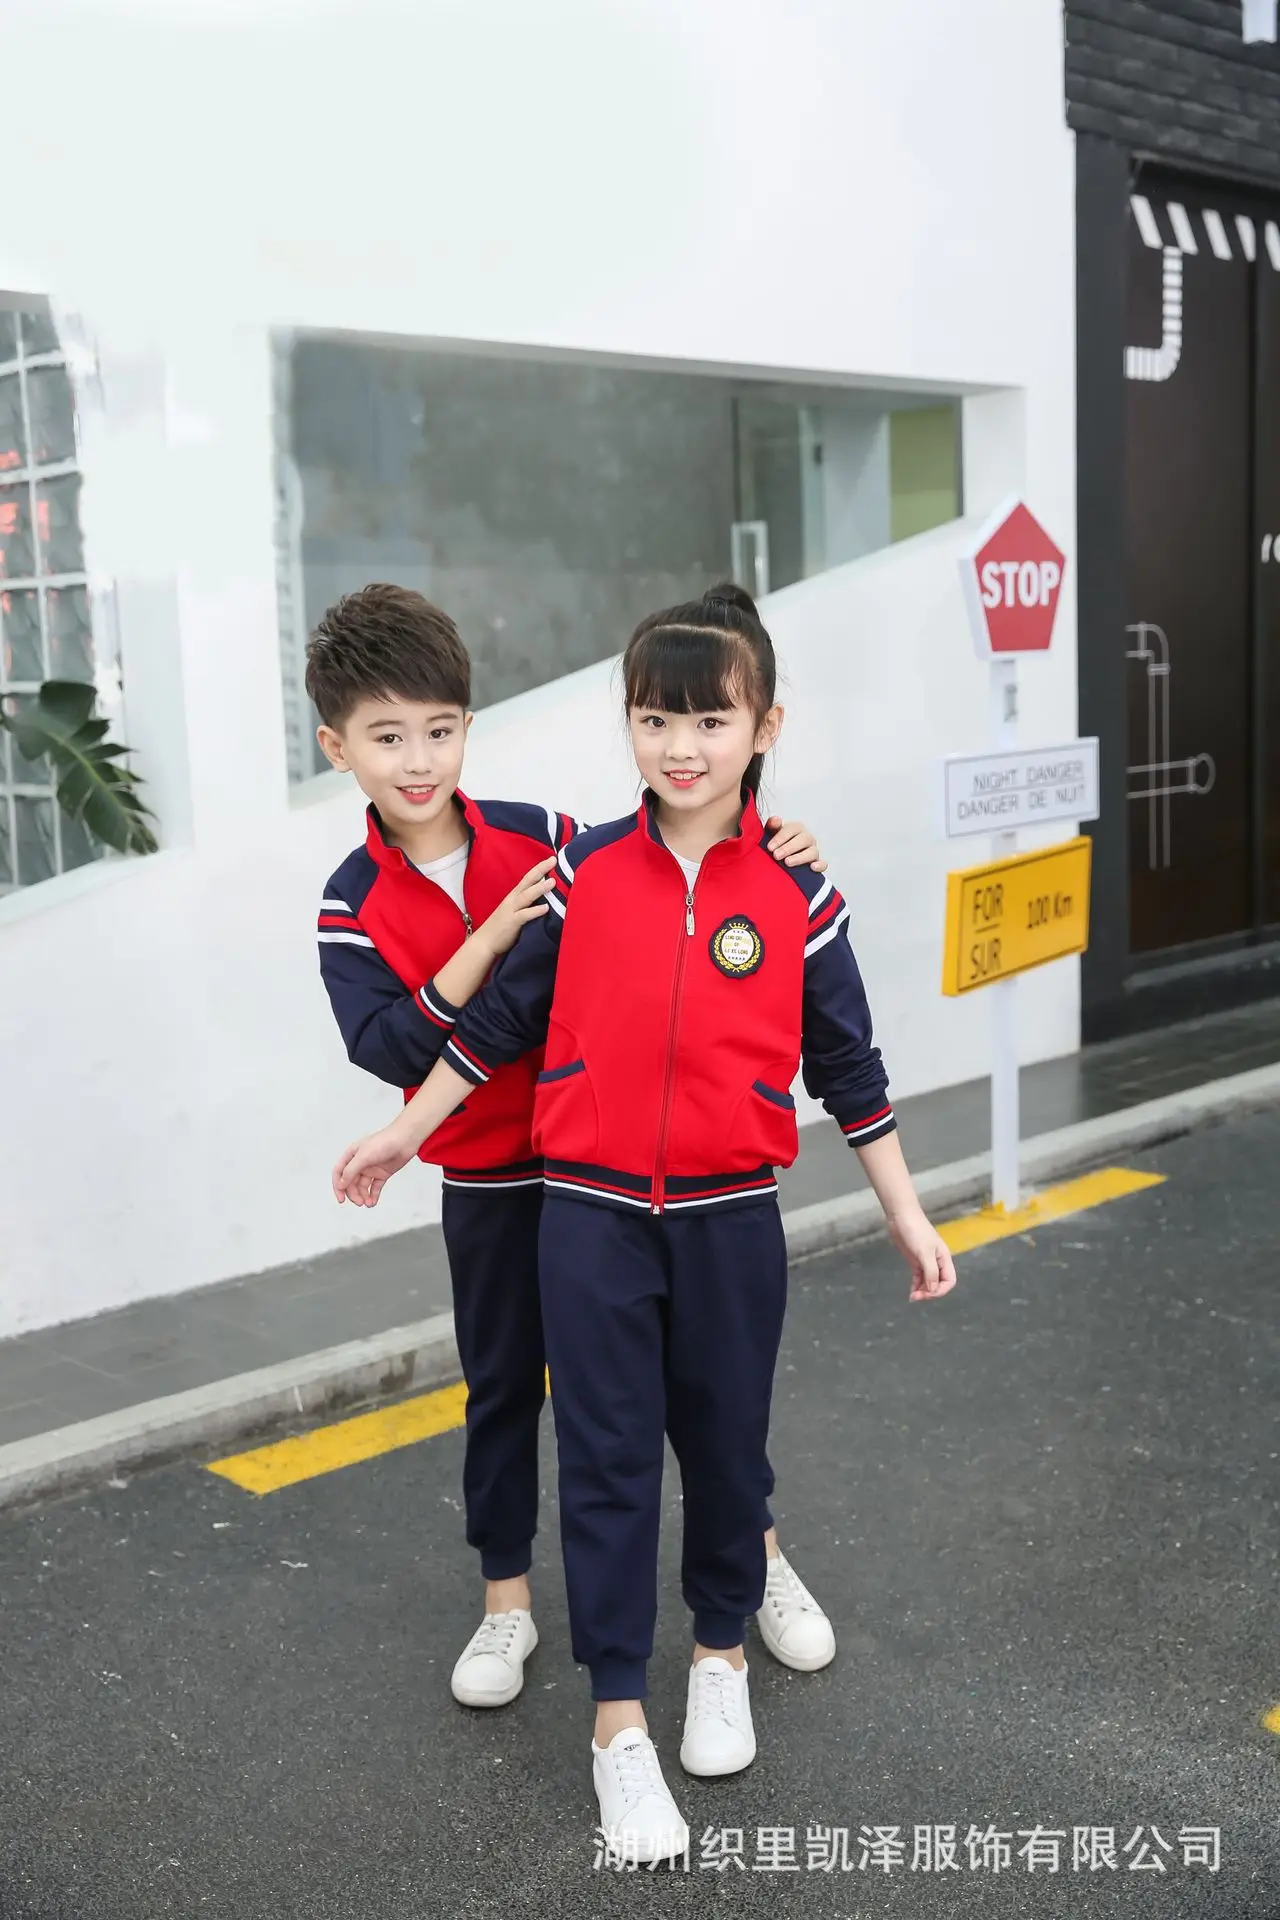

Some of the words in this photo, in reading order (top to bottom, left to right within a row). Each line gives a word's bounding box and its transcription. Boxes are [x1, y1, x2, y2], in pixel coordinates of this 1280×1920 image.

[981, 560, 1060, 608] STOP
[973, 769, 1017, 791] NIGHT
[1026, 760, 1084, 784] DANGER
[957, 793, 1019, 820] DANGER
[1028, 790, 1047, 810] DE
[972, 882, 1004, 925] FOR
[1026, 895, 1049, 930] 100
[970, 937, 1002, 980] SUR
